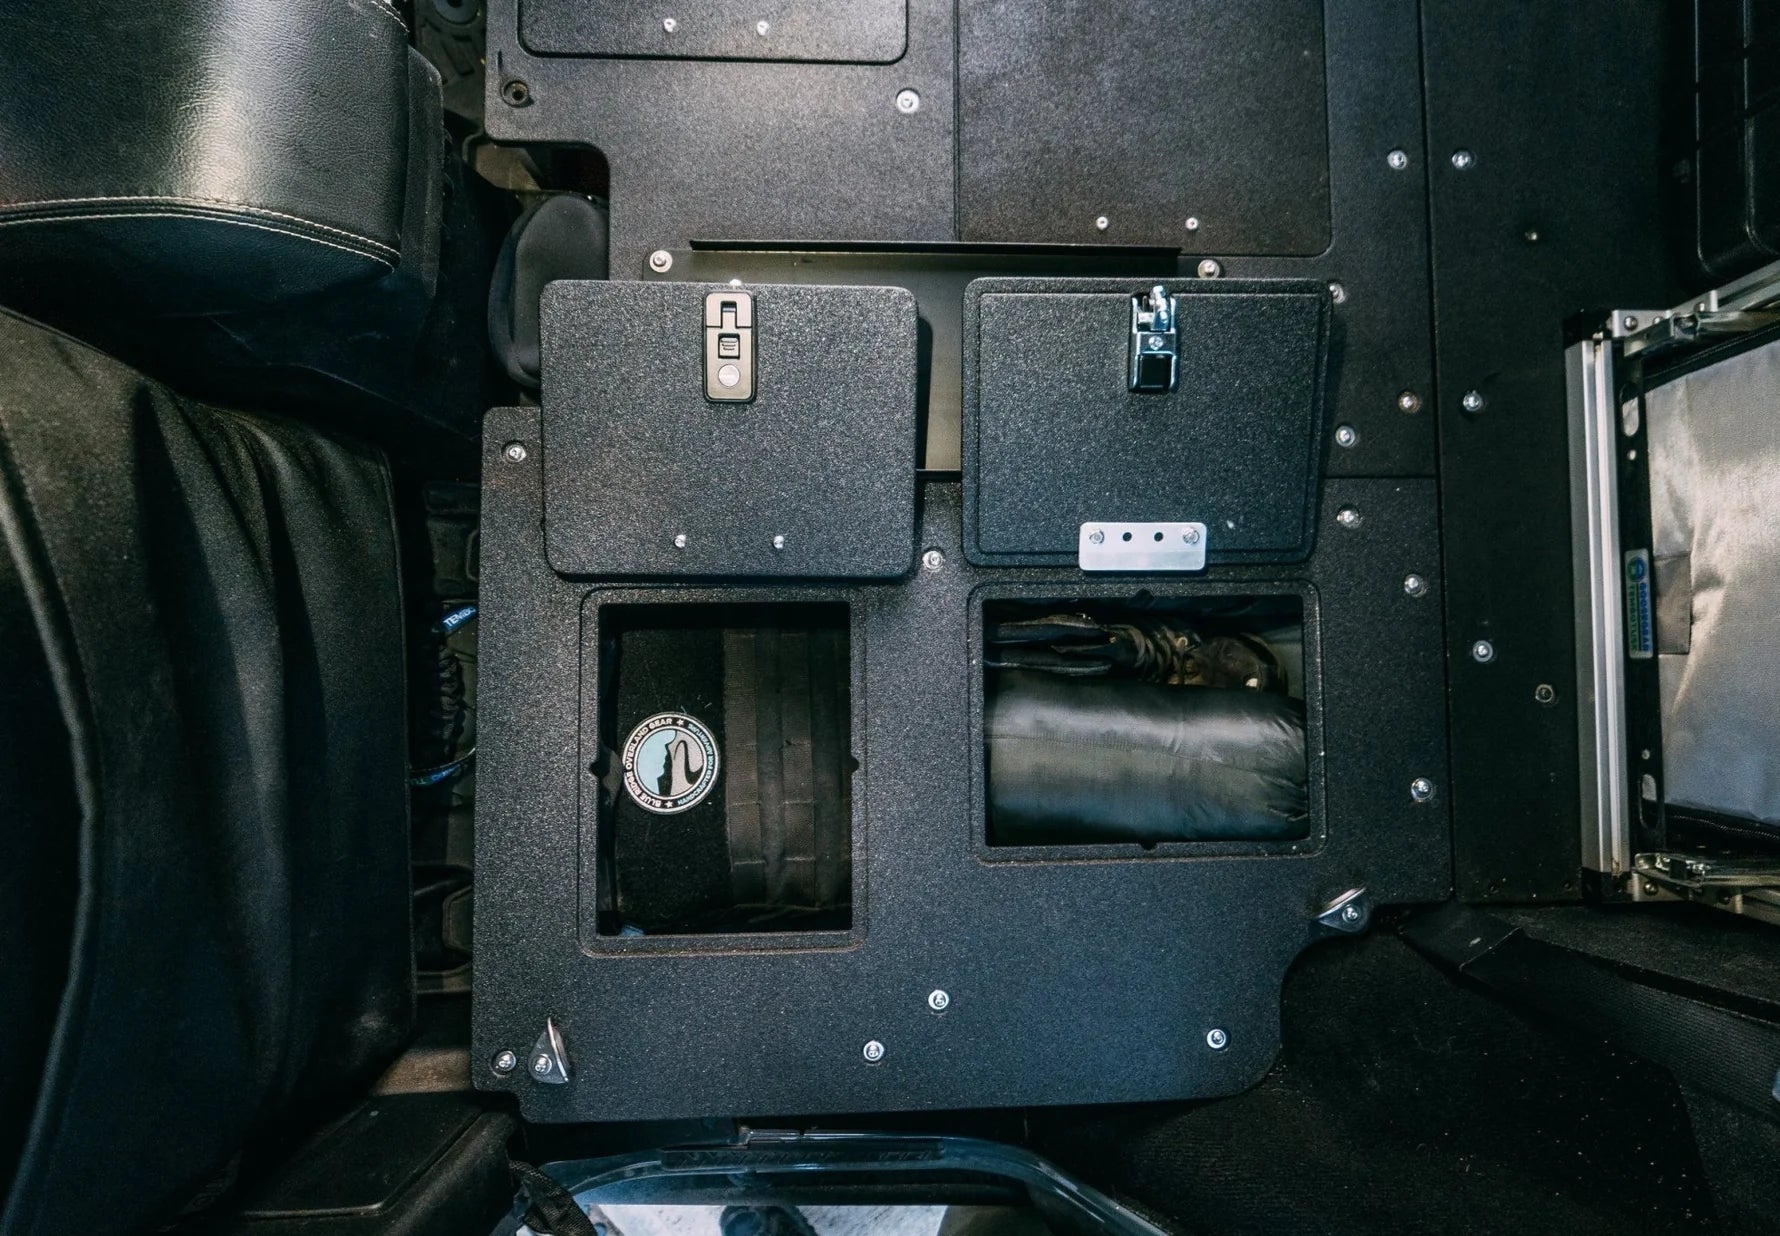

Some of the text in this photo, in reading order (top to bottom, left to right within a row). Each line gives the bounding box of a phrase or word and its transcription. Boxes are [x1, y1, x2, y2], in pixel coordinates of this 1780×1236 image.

[625, 718, 673, 808] BLUE RIDGE OVERLAND GEAR
[677, 770, 712, 805] HANDCRAFTED
